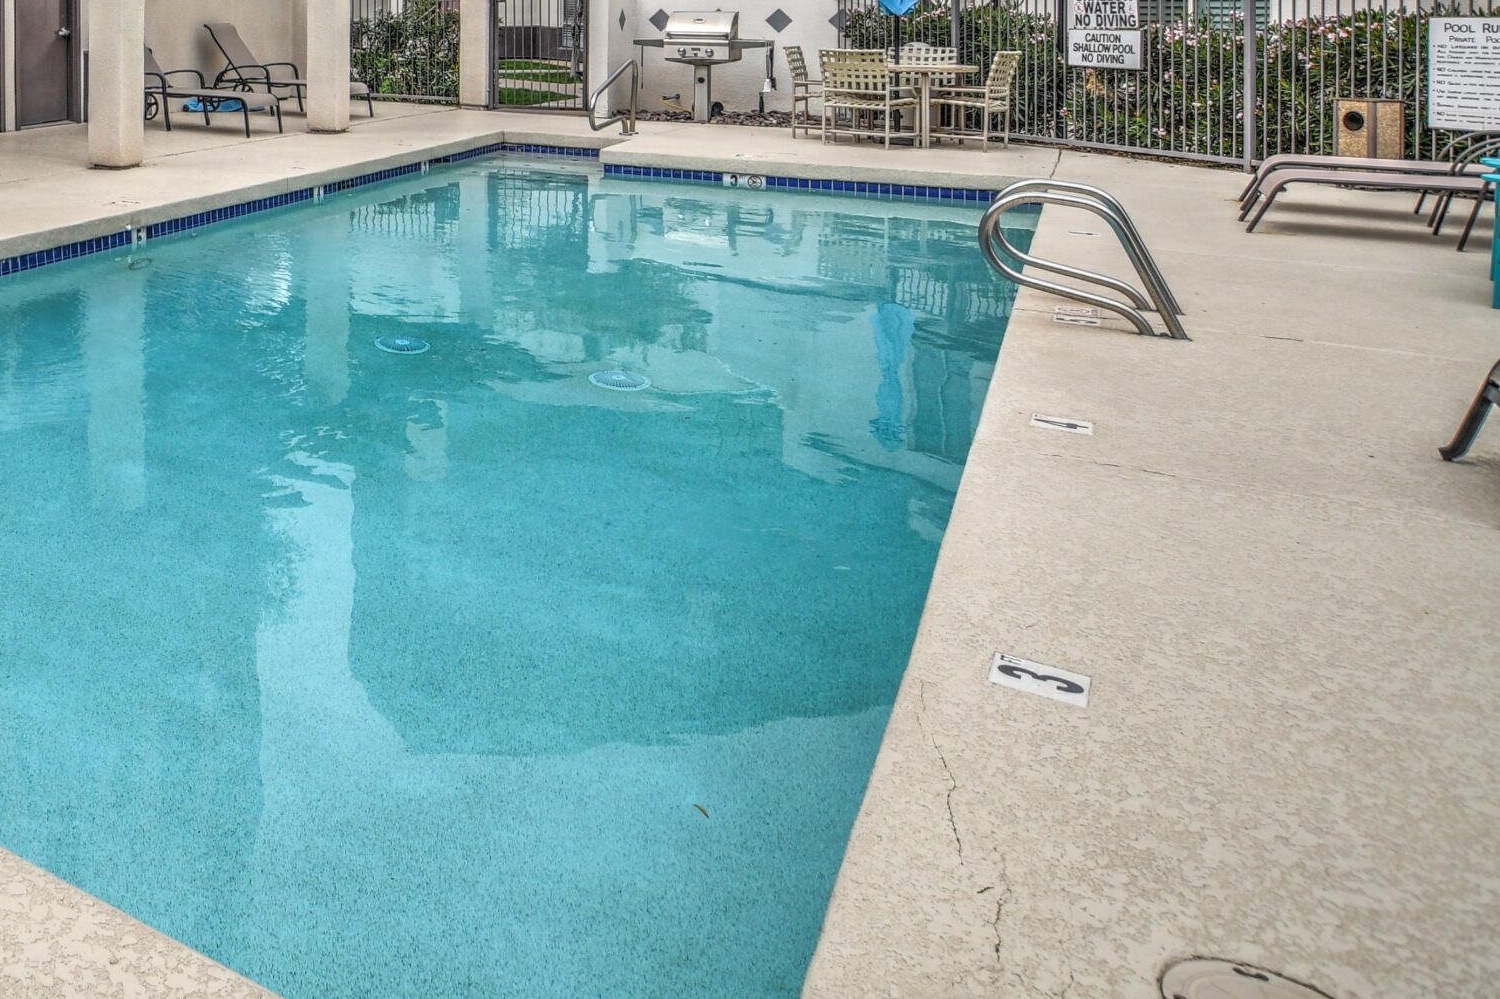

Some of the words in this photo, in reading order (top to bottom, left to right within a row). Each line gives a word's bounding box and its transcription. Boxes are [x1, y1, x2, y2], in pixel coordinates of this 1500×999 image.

[1084, 2, 1126, 14] WATER
[1075, 14, 1091, 26] NO
[1096, 15, 1136, 27] DIVING
[1444, 22, 1476, 33] POOL
[1482, 23, 1500, 33] RU
[1085, 33, 1121, 43] CAUTION
[1073, 43, 1111, 53] SHALLOW
[1113, 44, 1136, 54] POOL
[1082, 53, 1094, 63] NO
[1097, 54, 1125, 64] DIVING
[730, 174, 738, 187] 3
[998, 664, 1085, 694] 3
